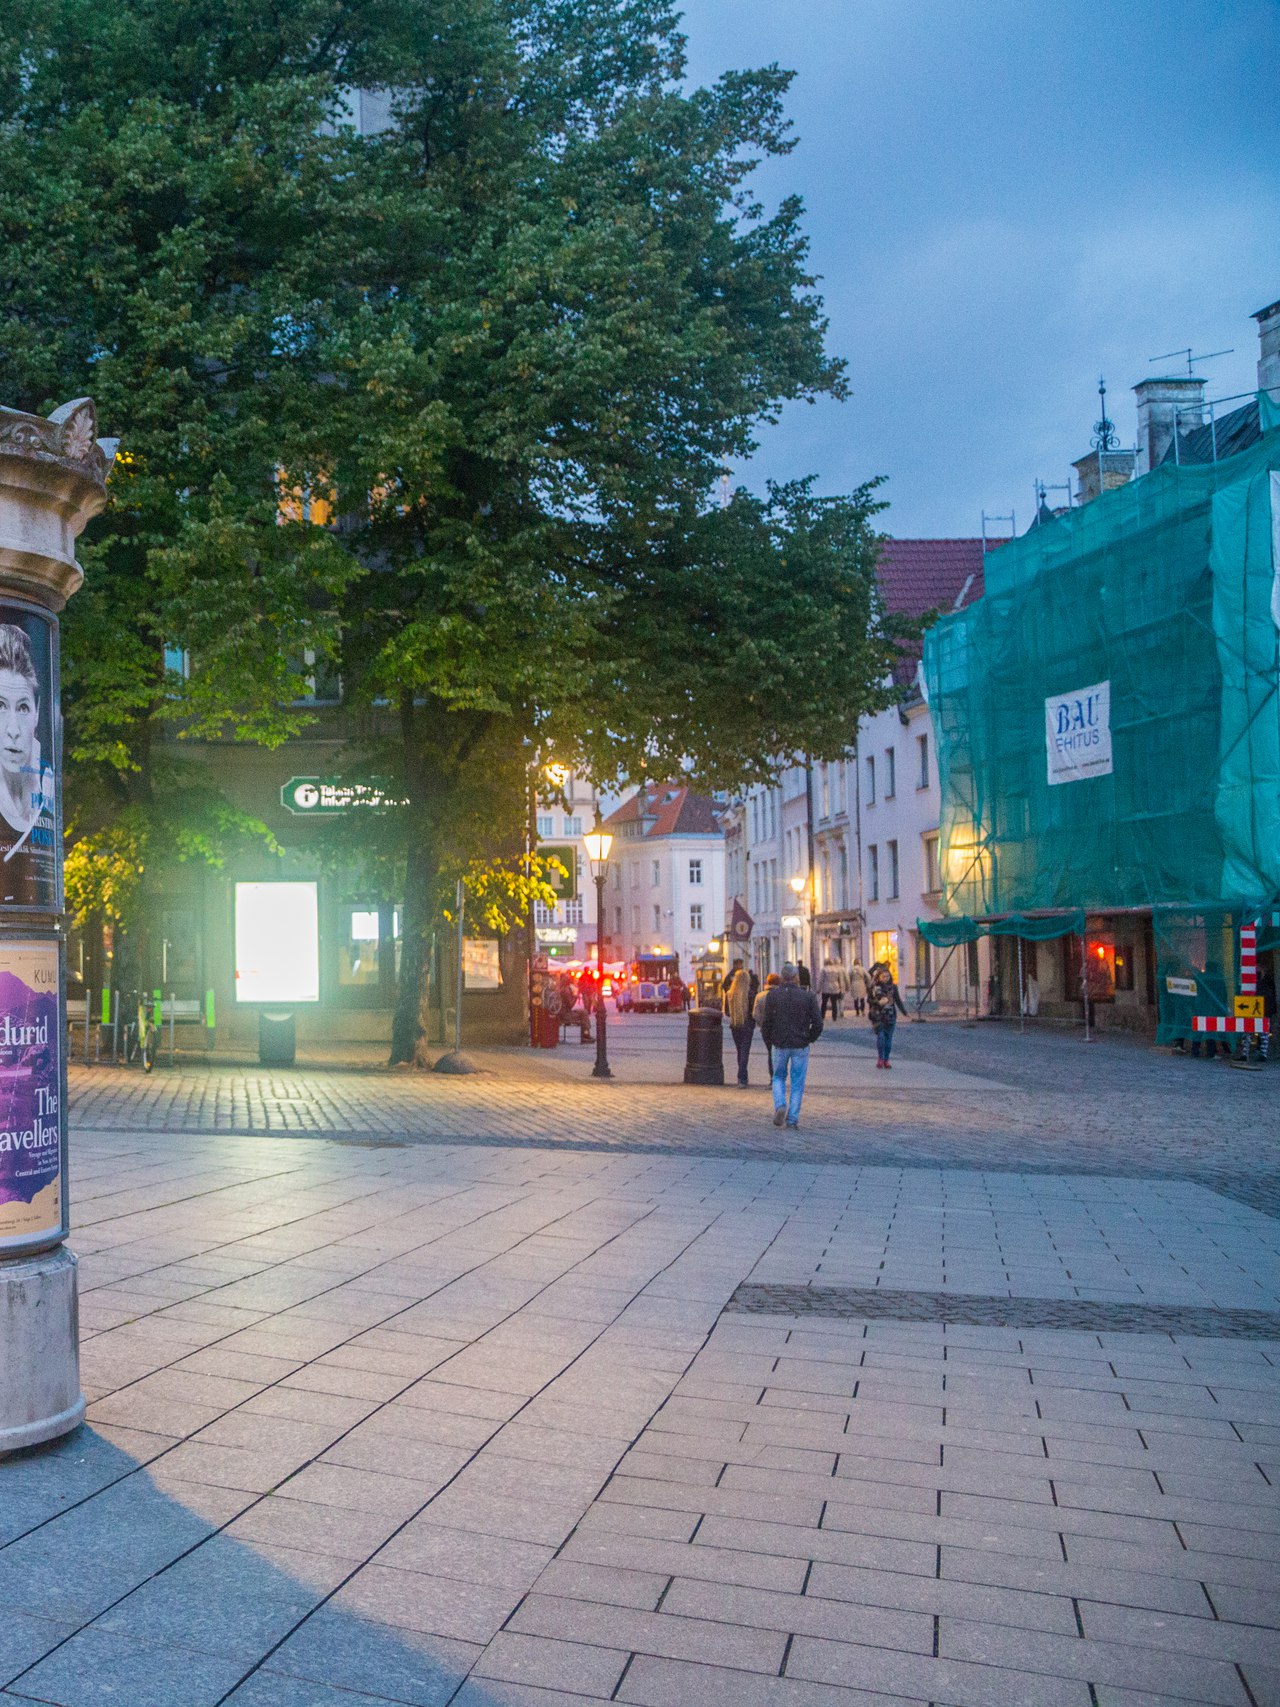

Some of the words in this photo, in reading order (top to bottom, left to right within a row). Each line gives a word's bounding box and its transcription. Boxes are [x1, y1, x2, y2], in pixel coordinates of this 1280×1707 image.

[1057, 694, 1100, 734] BAU
[1056, 729, 1100, 753] EHITUS
[34, 1086, 58, 1116] The
[15, 1168, 33, 1177] Central
